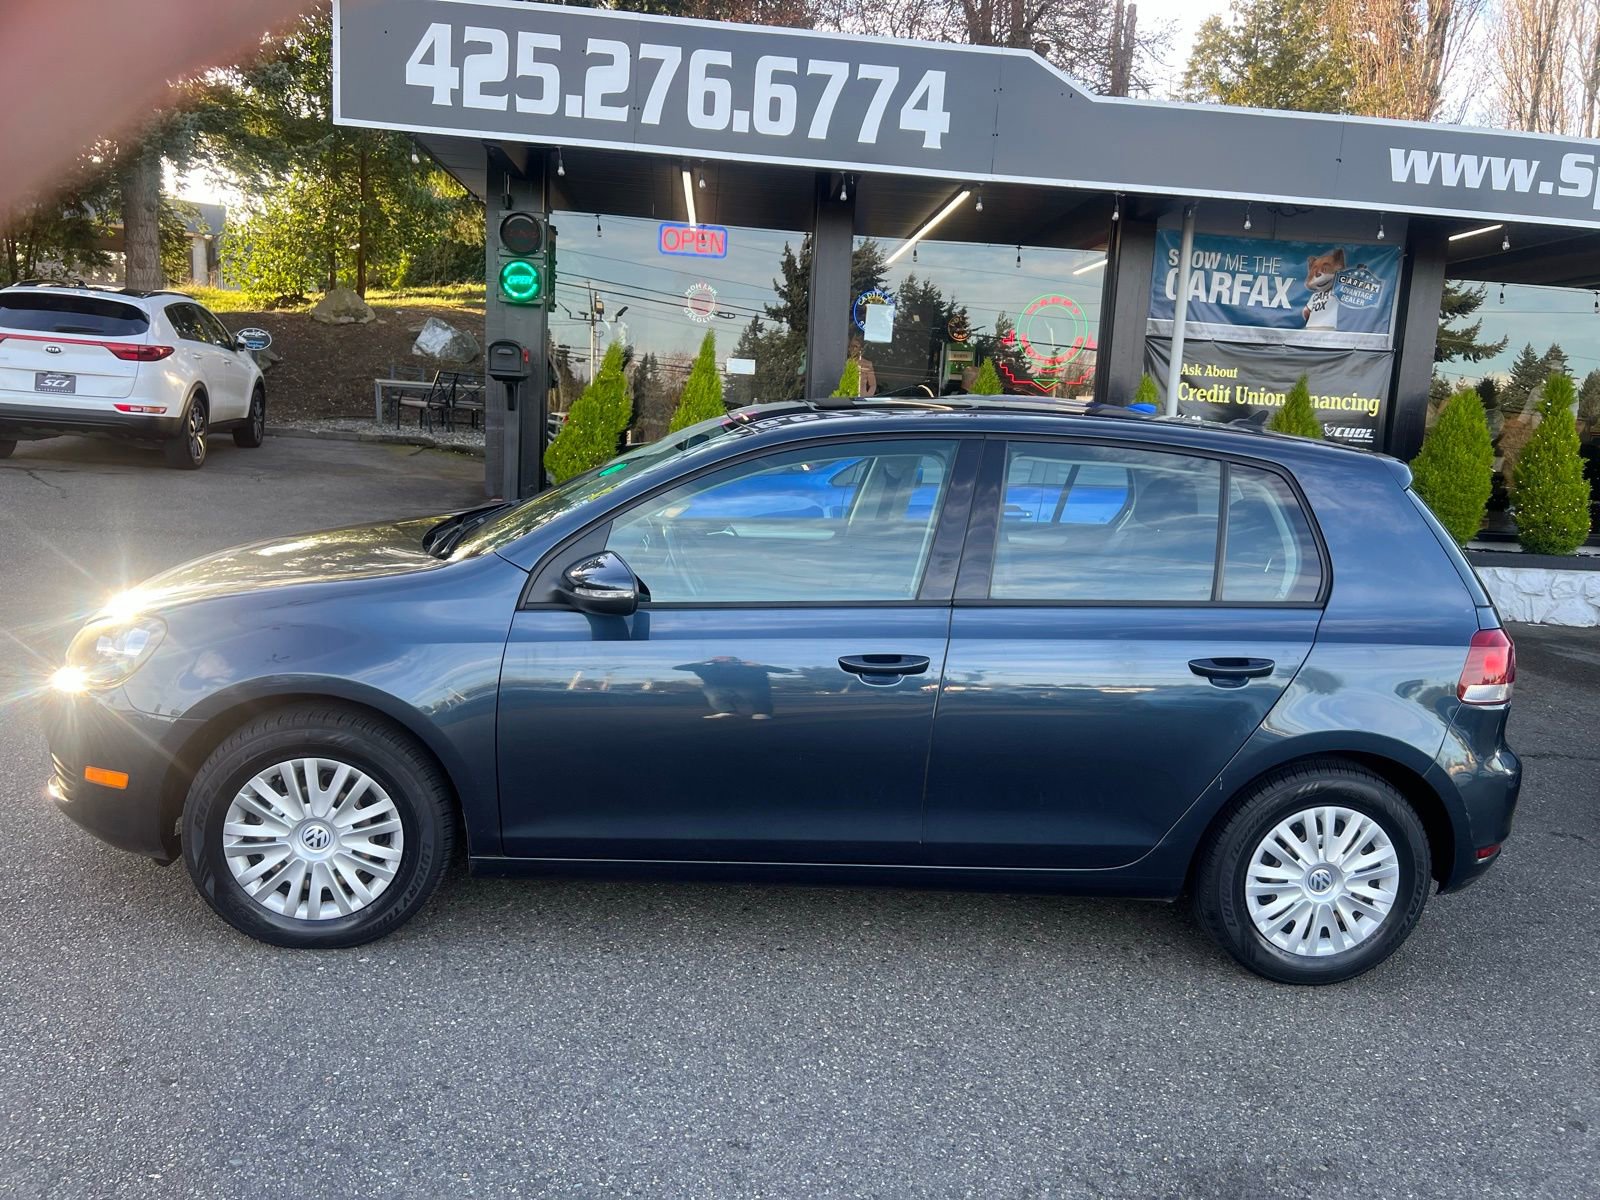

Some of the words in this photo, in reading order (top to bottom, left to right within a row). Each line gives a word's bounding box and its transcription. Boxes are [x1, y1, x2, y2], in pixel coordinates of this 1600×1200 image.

[405, 22, 952, 150] 425.276.6774
[1389, 147, 1600, 210] www.S
[662, 226, 726, 255] OPEN
[1168, 248, 1222, 270] SOW
[1224, 253, 1249, 272] ME
[1252, 256, 1282, 275] THE
[507, 275, 535, 285] OPEN
[1165, 267, 1294, 310] CARFAX
[1339, 275, 1379, 294] CARFAX
[1340, 286, 1374, 301] ADVANTAGE
[1340, 294, 1365, 306] DEALER
[1312, 300, 1328, 312] FOX
[1181, 363, 1202, 376] Ask
[1204, 365, 1239, 378] About
[1178, 382, 1231, 404] Credit
[1235, 386, 1286, 407] Union
[1308, 392, 1380, 417] nancing
